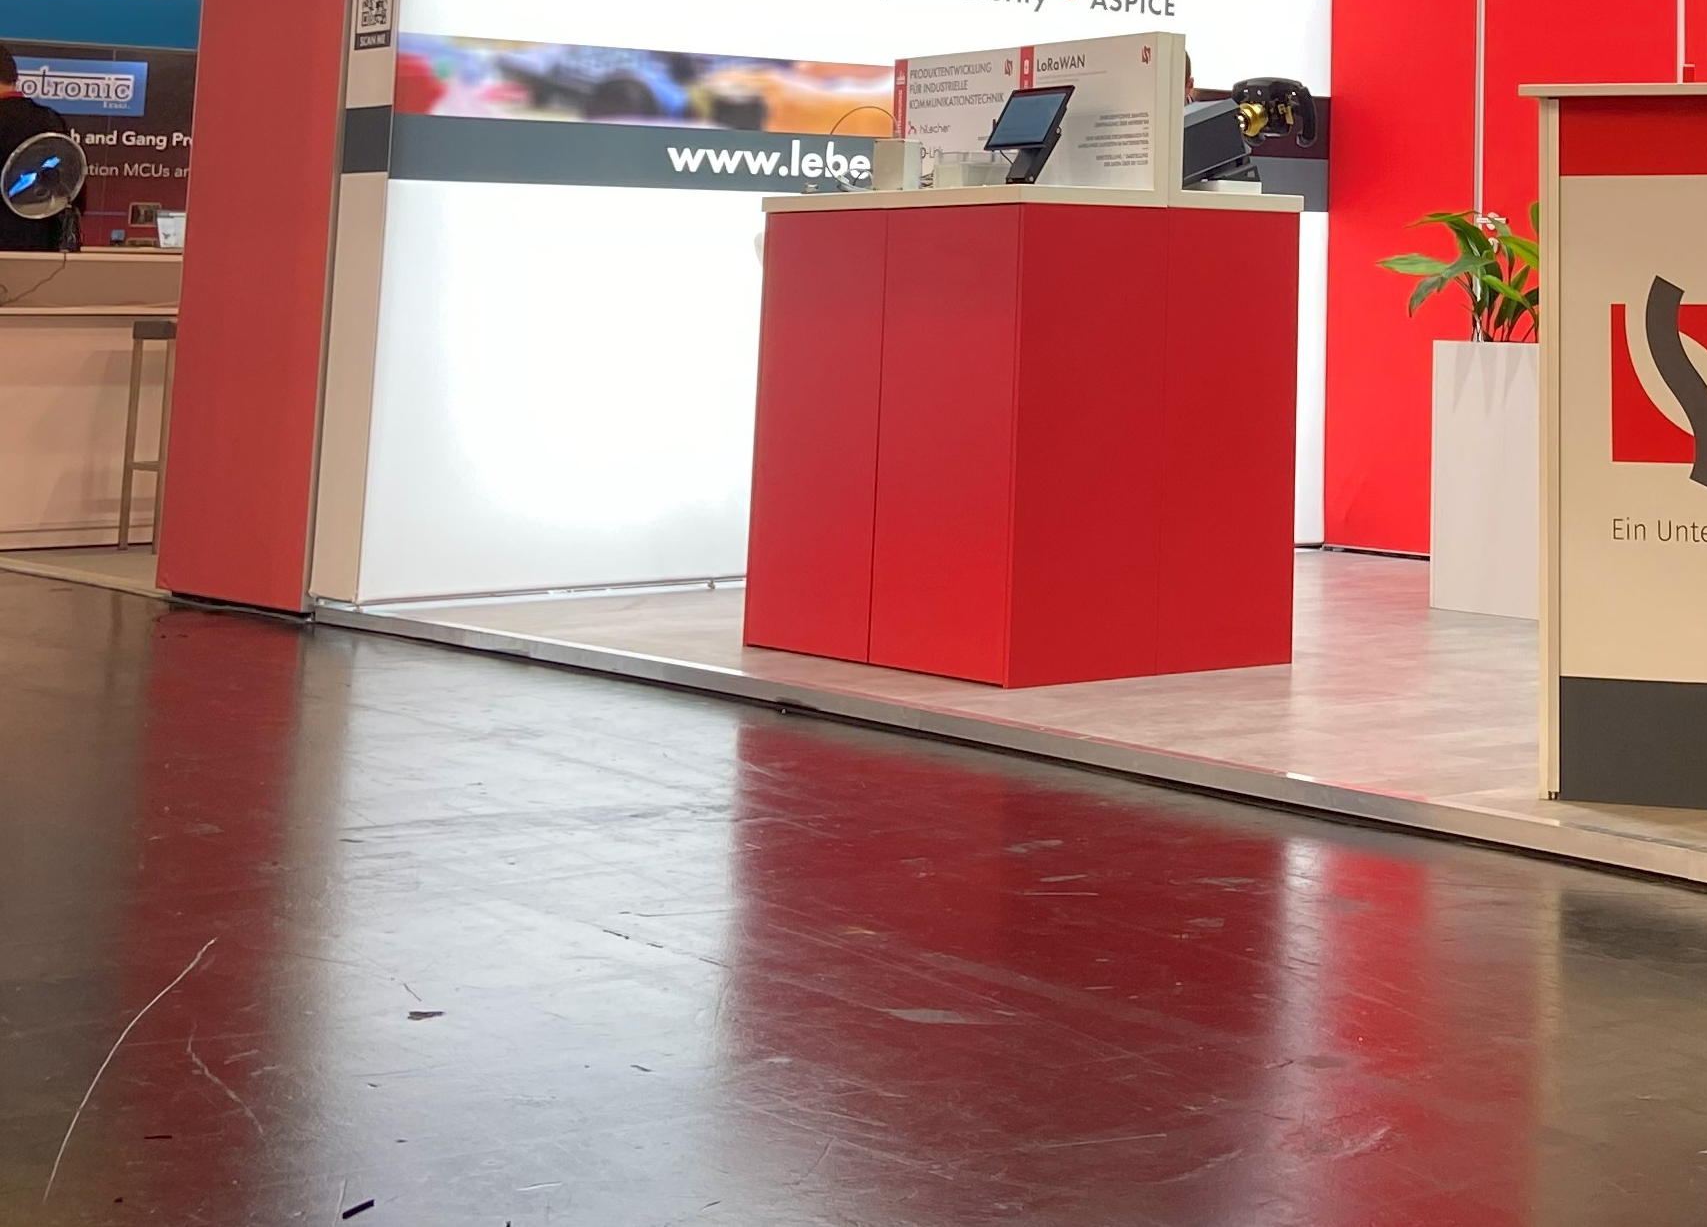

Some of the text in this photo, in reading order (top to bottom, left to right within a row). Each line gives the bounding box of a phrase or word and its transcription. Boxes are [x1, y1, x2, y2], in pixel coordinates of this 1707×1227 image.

[1036, 54, 1086, 72] LoRaWAN
[85, 129, 118, 146] and
[122, 130, 168, 150] Gang
[123, 163, 170, 178] MCUs
[1612, 517, 1647, 542] Ein
